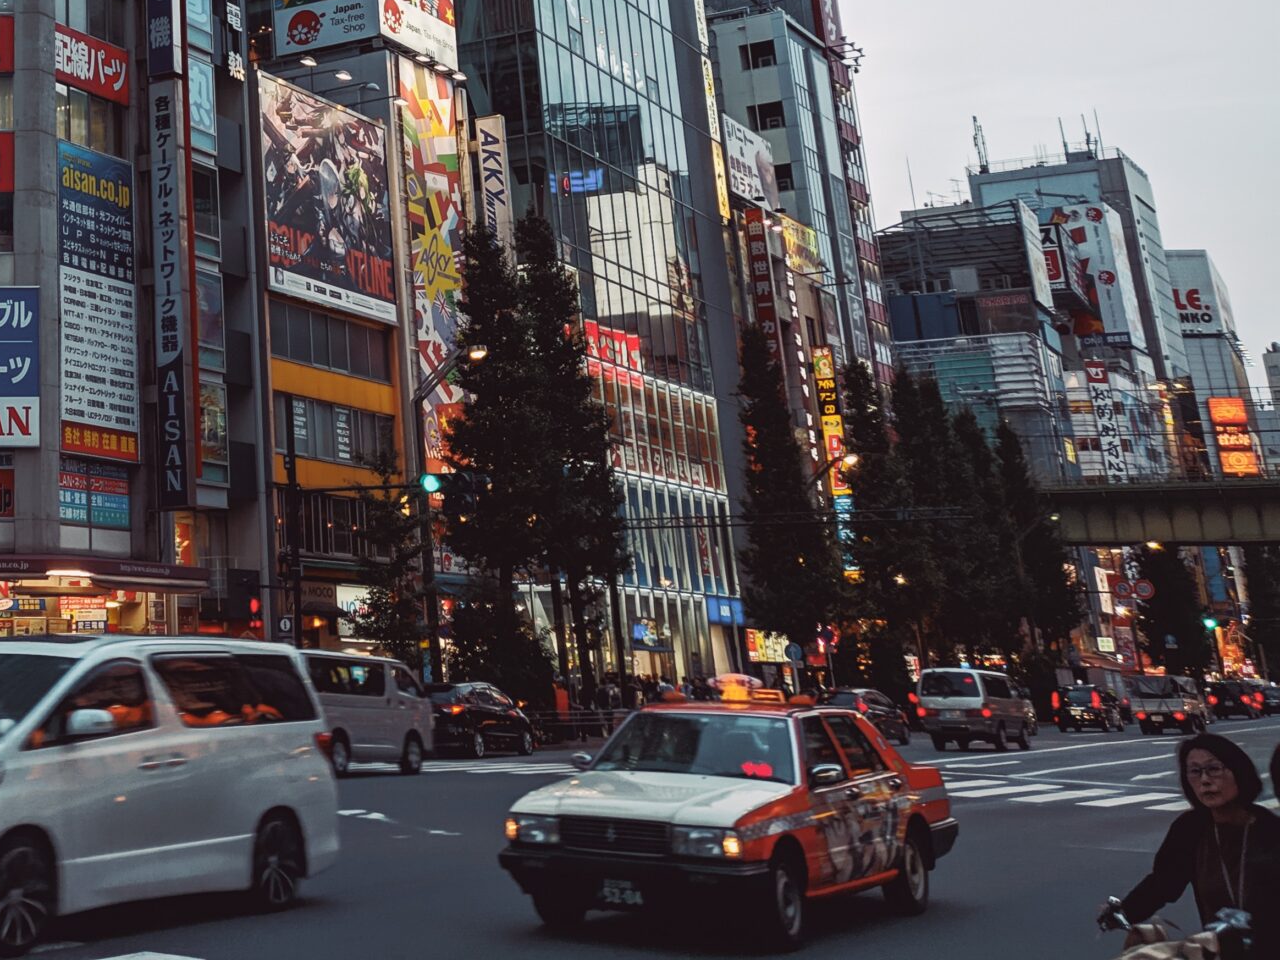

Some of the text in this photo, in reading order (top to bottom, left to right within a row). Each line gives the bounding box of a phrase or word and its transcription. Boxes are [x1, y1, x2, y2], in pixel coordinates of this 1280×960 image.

[330, 12, 365, 26] Tax-free
[333, 1, 365, 15] Japan.
[343, 22, 366, 34] Shop
[54, 33, 128, 92] 配線パーツ
[62, 164, 130, 209] aisan.co.jp
[480, 128, 506, 206] AKKY
[154, 95, 179, 354] 各種ケーブル・ネットワーク機器
[748, 221, 778, 354] 曲数世界一カラ
[162, 370, 183, 492] AISAN
